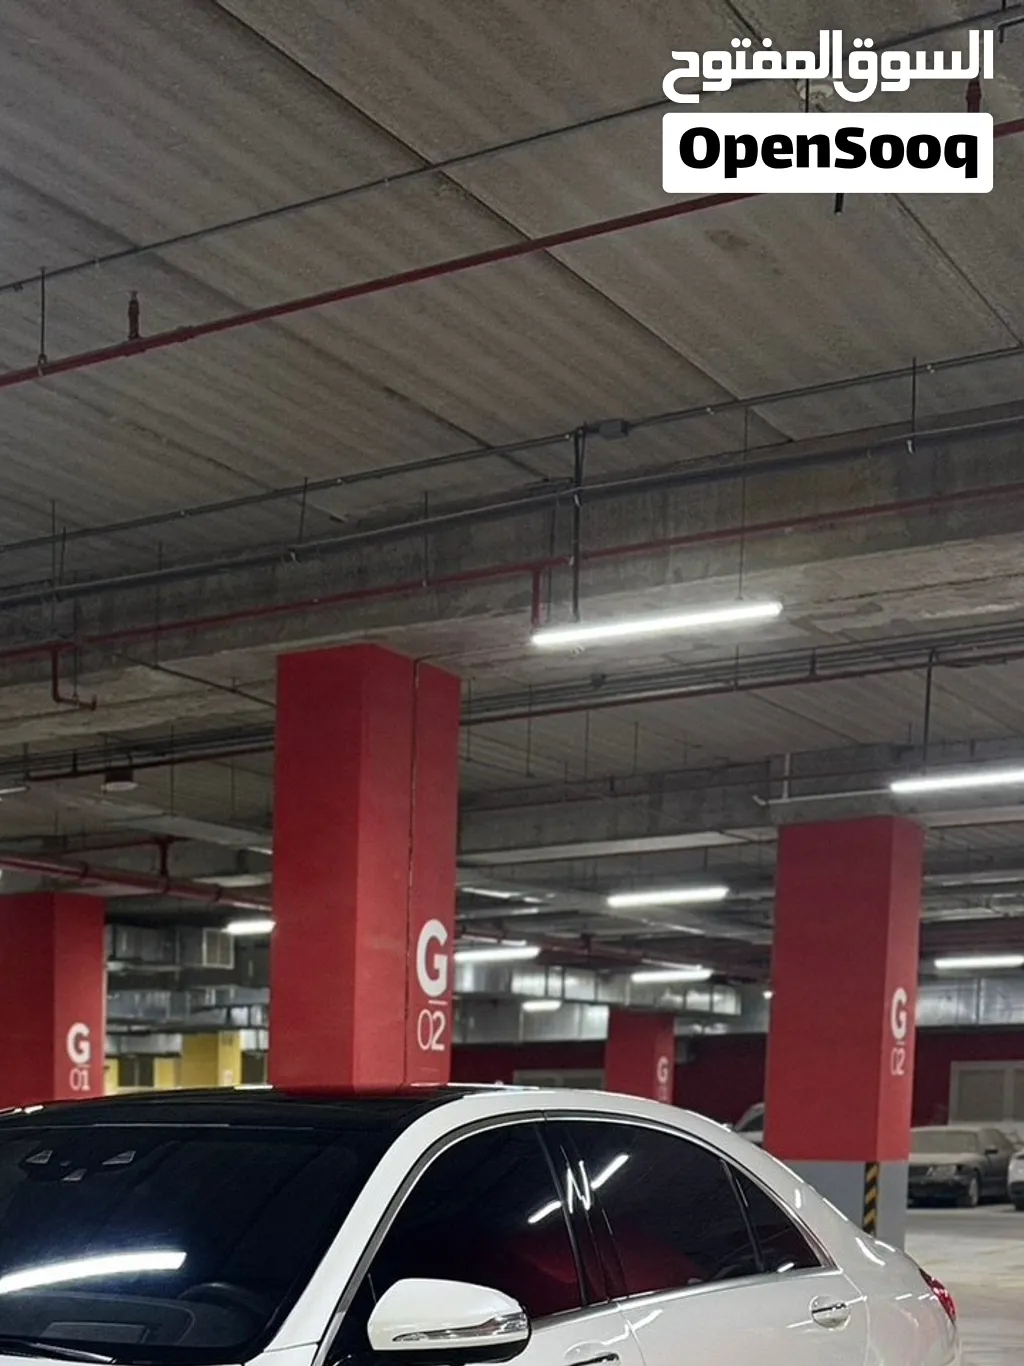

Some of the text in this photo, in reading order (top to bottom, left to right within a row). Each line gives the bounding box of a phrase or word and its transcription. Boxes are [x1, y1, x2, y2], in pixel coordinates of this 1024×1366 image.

[416, 918, 448, 997] G
[417, 1008, 446, 1051] 02
[890, 987, 908, 1040] G
[66, 1022, 91, 1065] G
[890, 1047, 906, 1076] 02
[69, 1067, 91, 1092] 01
[657, 1055, 669, 1084] G
